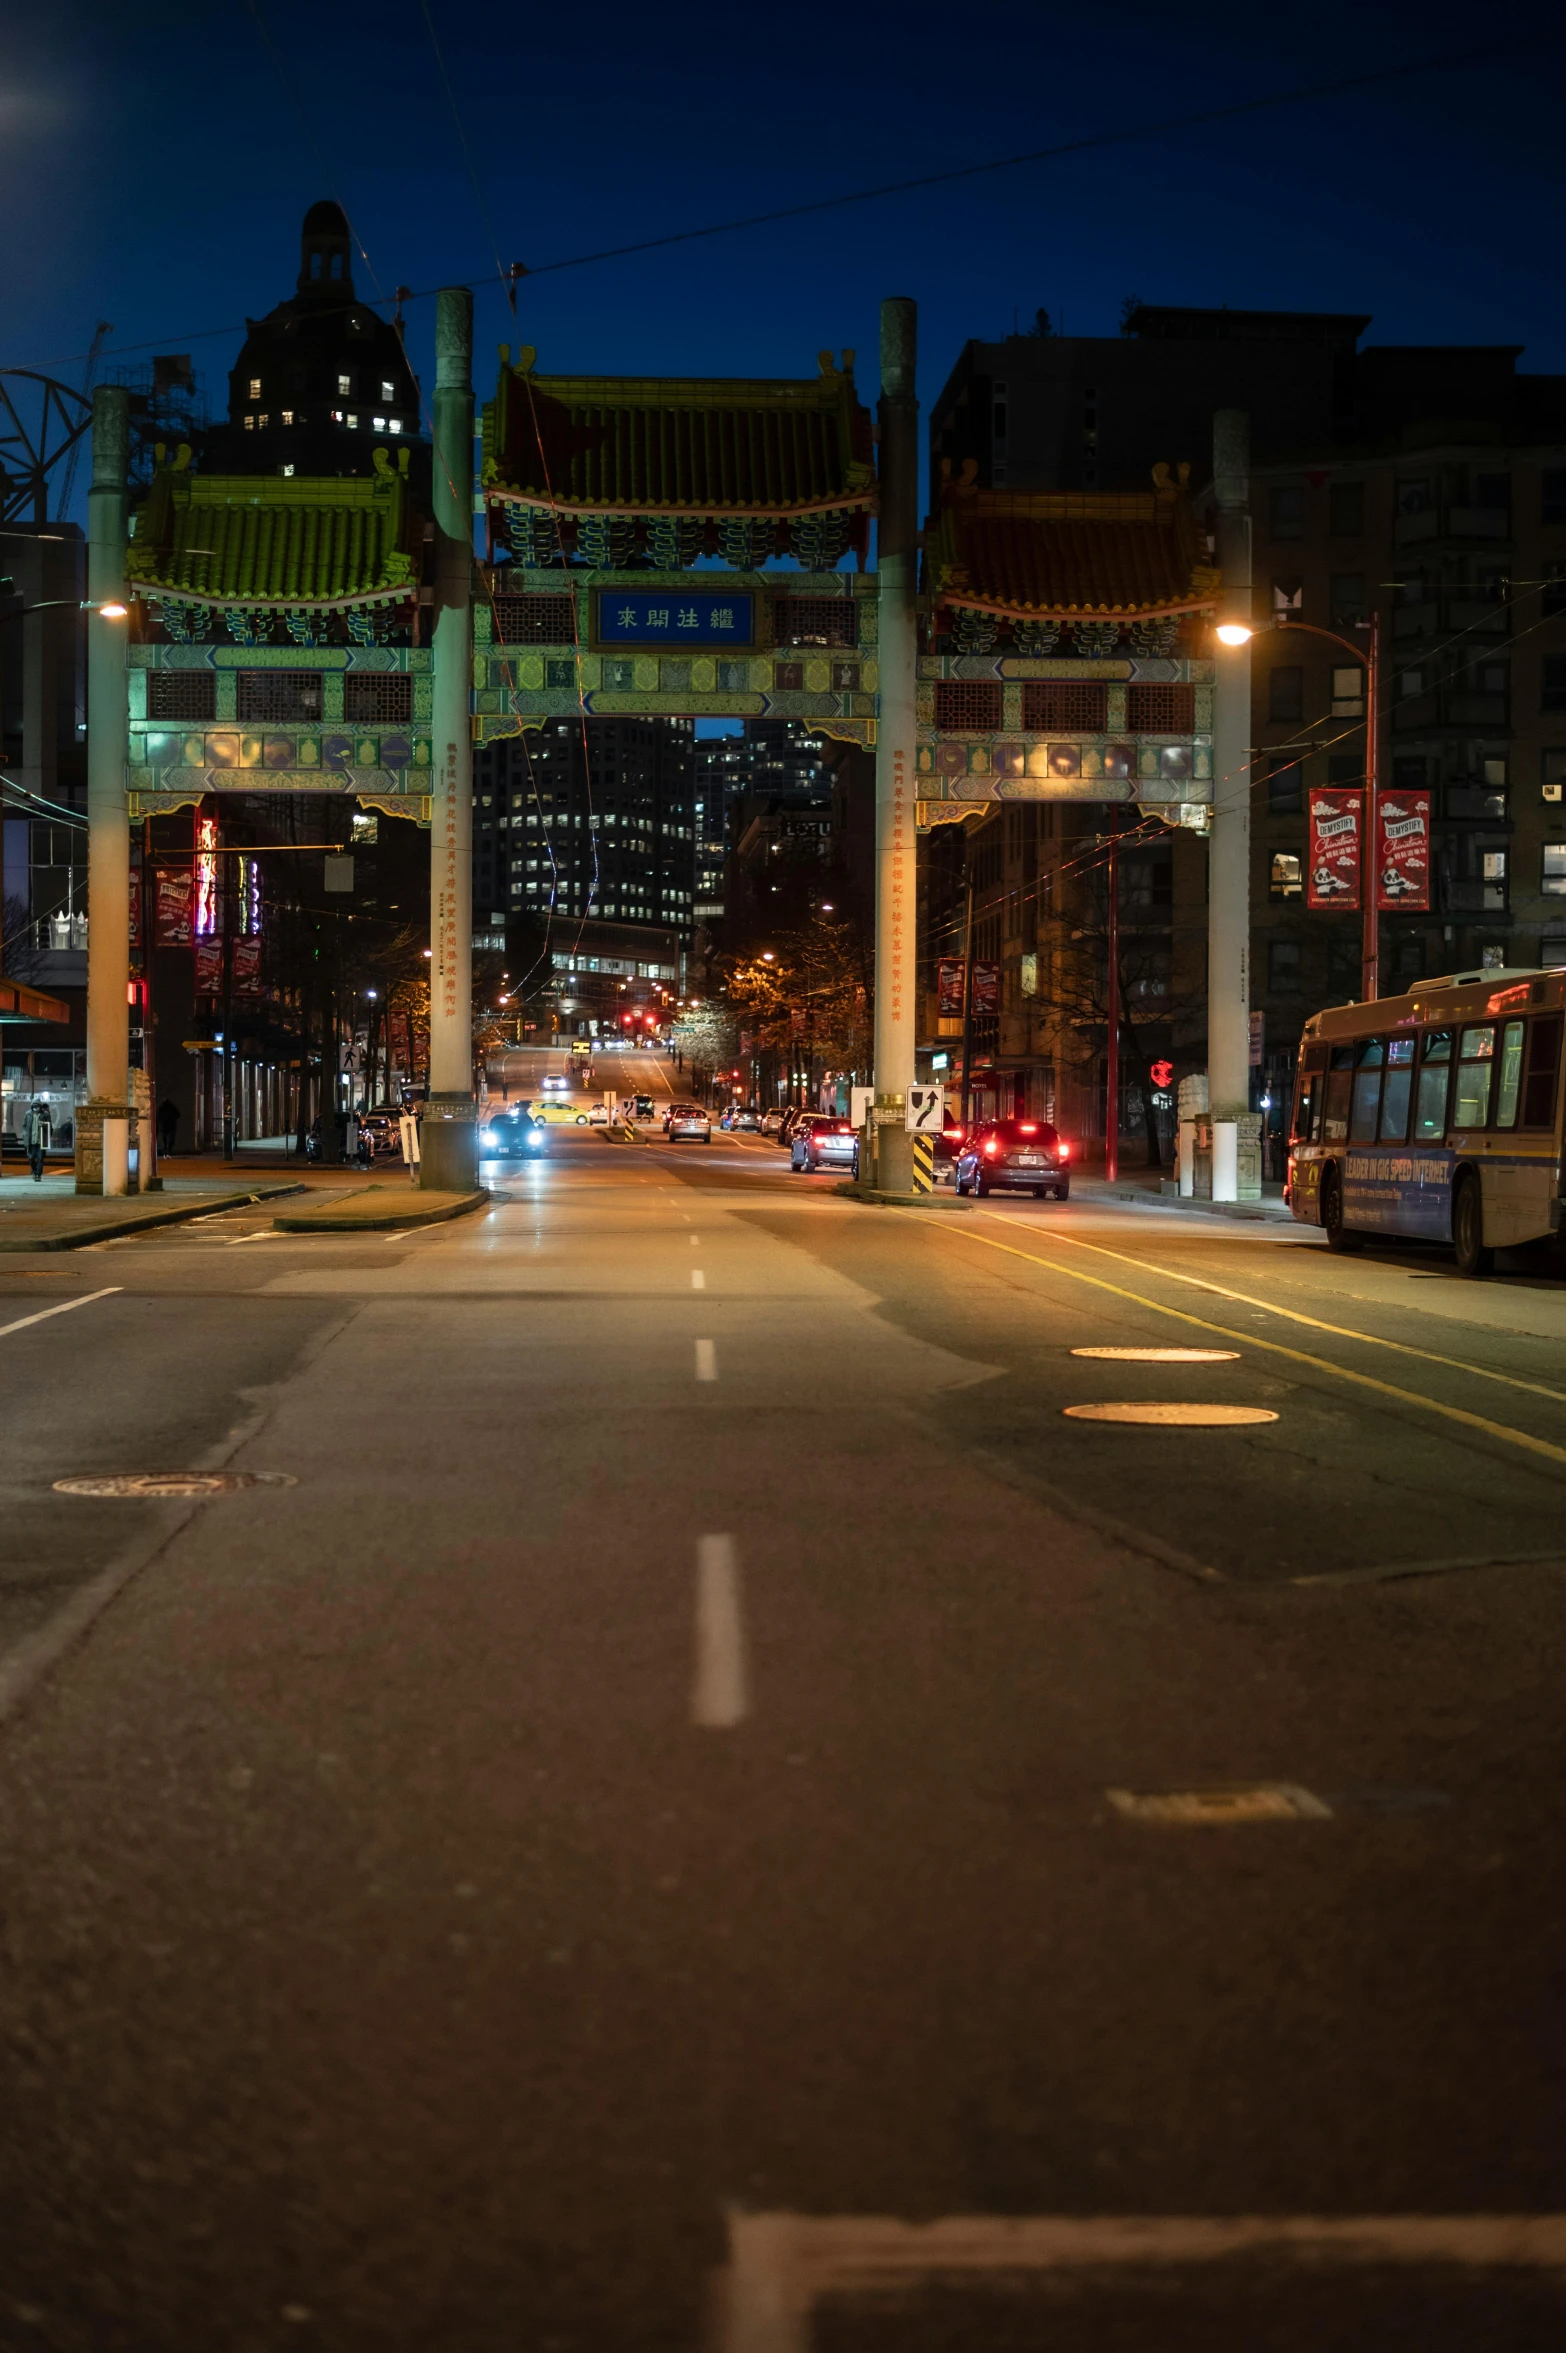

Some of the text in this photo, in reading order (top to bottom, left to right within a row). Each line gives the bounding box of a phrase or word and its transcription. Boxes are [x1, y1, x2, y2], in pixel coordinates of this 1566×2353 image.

[1320, 817, 1353, 836] DEMYSTIFY
[1388, 819, 1421, 838] DEMYSTIFY
[1315, 834, 1359, 854] Chinatown
[1383, 836, 1427, 855] Chinatown
[1344, 1156, 1369, 1180] LEADER
[1369, 1158, 1377, 1180] IN
[1377, 1158, 1390, 1181] GIG
[1390, 1158, 1412, 1182] SPEED
